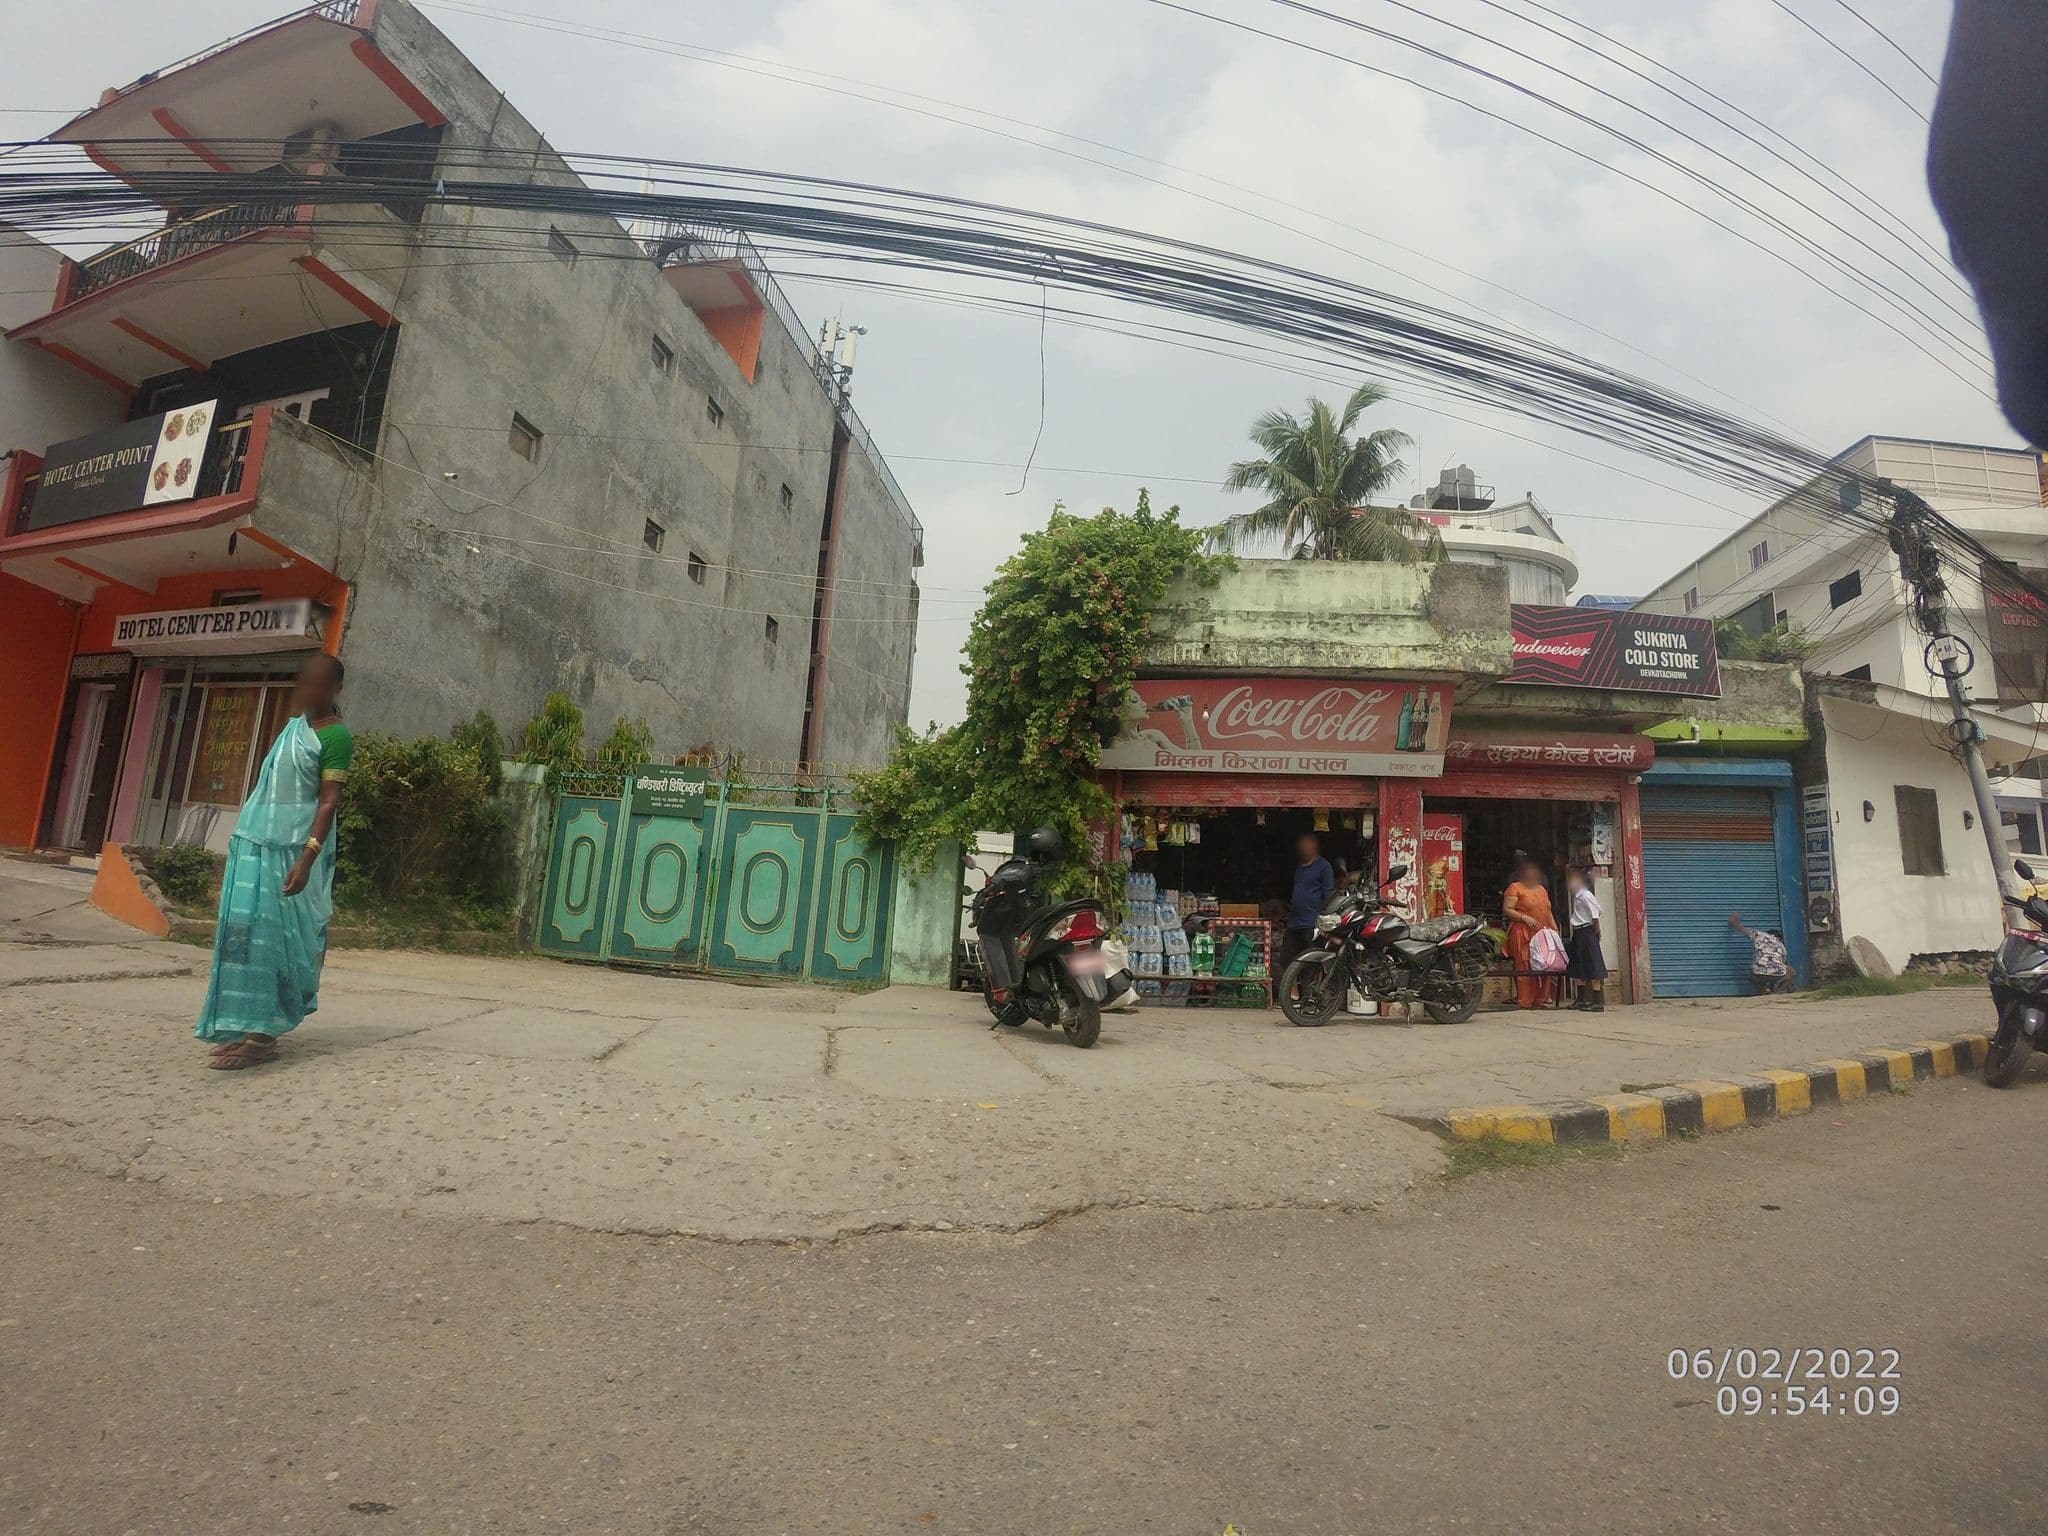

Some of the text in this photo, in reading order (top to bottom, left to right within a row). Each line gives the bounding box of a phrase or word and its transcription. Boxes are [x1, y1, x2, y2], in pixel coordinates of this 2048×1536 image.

[43, 464, 75, 487] HOTEL
[75, 453, 115, 478] CENTER
[115, 445, 152, 468] POINT
[118, 618, 165, 640] HOTEL
[167, 611, 235, 636] CENTER
[1634, 630, 1688, 650] SUKRIYA
[1624, 649, 1700, 670] COLD STORE
[1208, 685, 1394, 742] Coca-Cola
[1154, 750, 1350, 772] मिलन किराना पसल
[1545, 741, 1591, 764] कोल्ड
